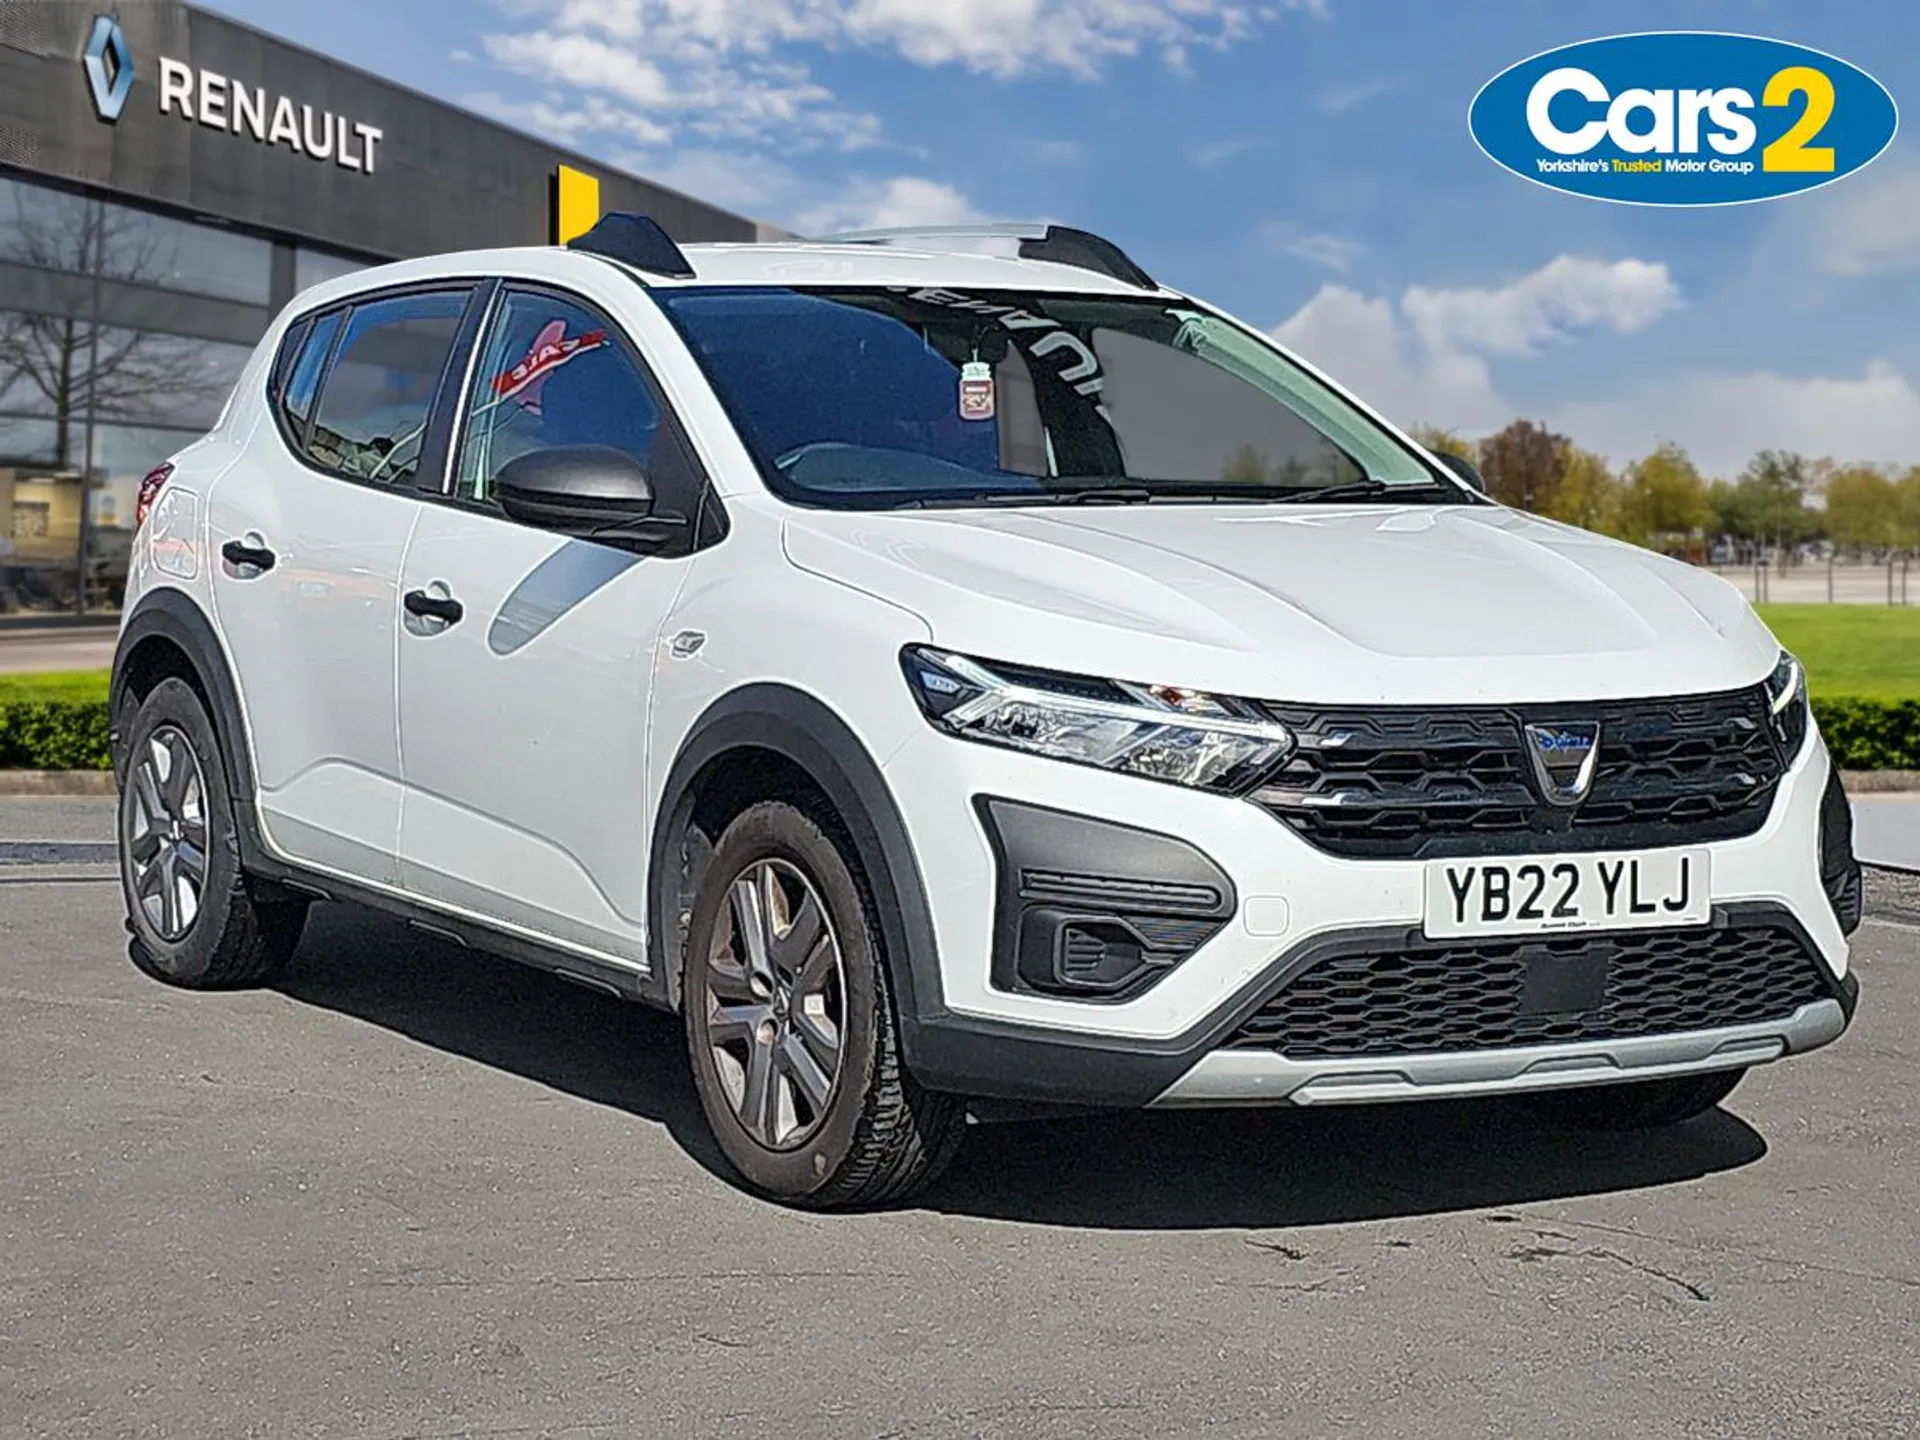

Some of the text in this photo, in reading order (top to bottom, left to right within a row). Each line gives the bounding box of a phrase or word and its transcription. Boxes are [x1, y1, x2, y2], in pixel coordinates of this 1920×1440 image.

[160, 56, 383, 173] RENAULT
[1446, 857, 1689, 923] YB22 YLJ
